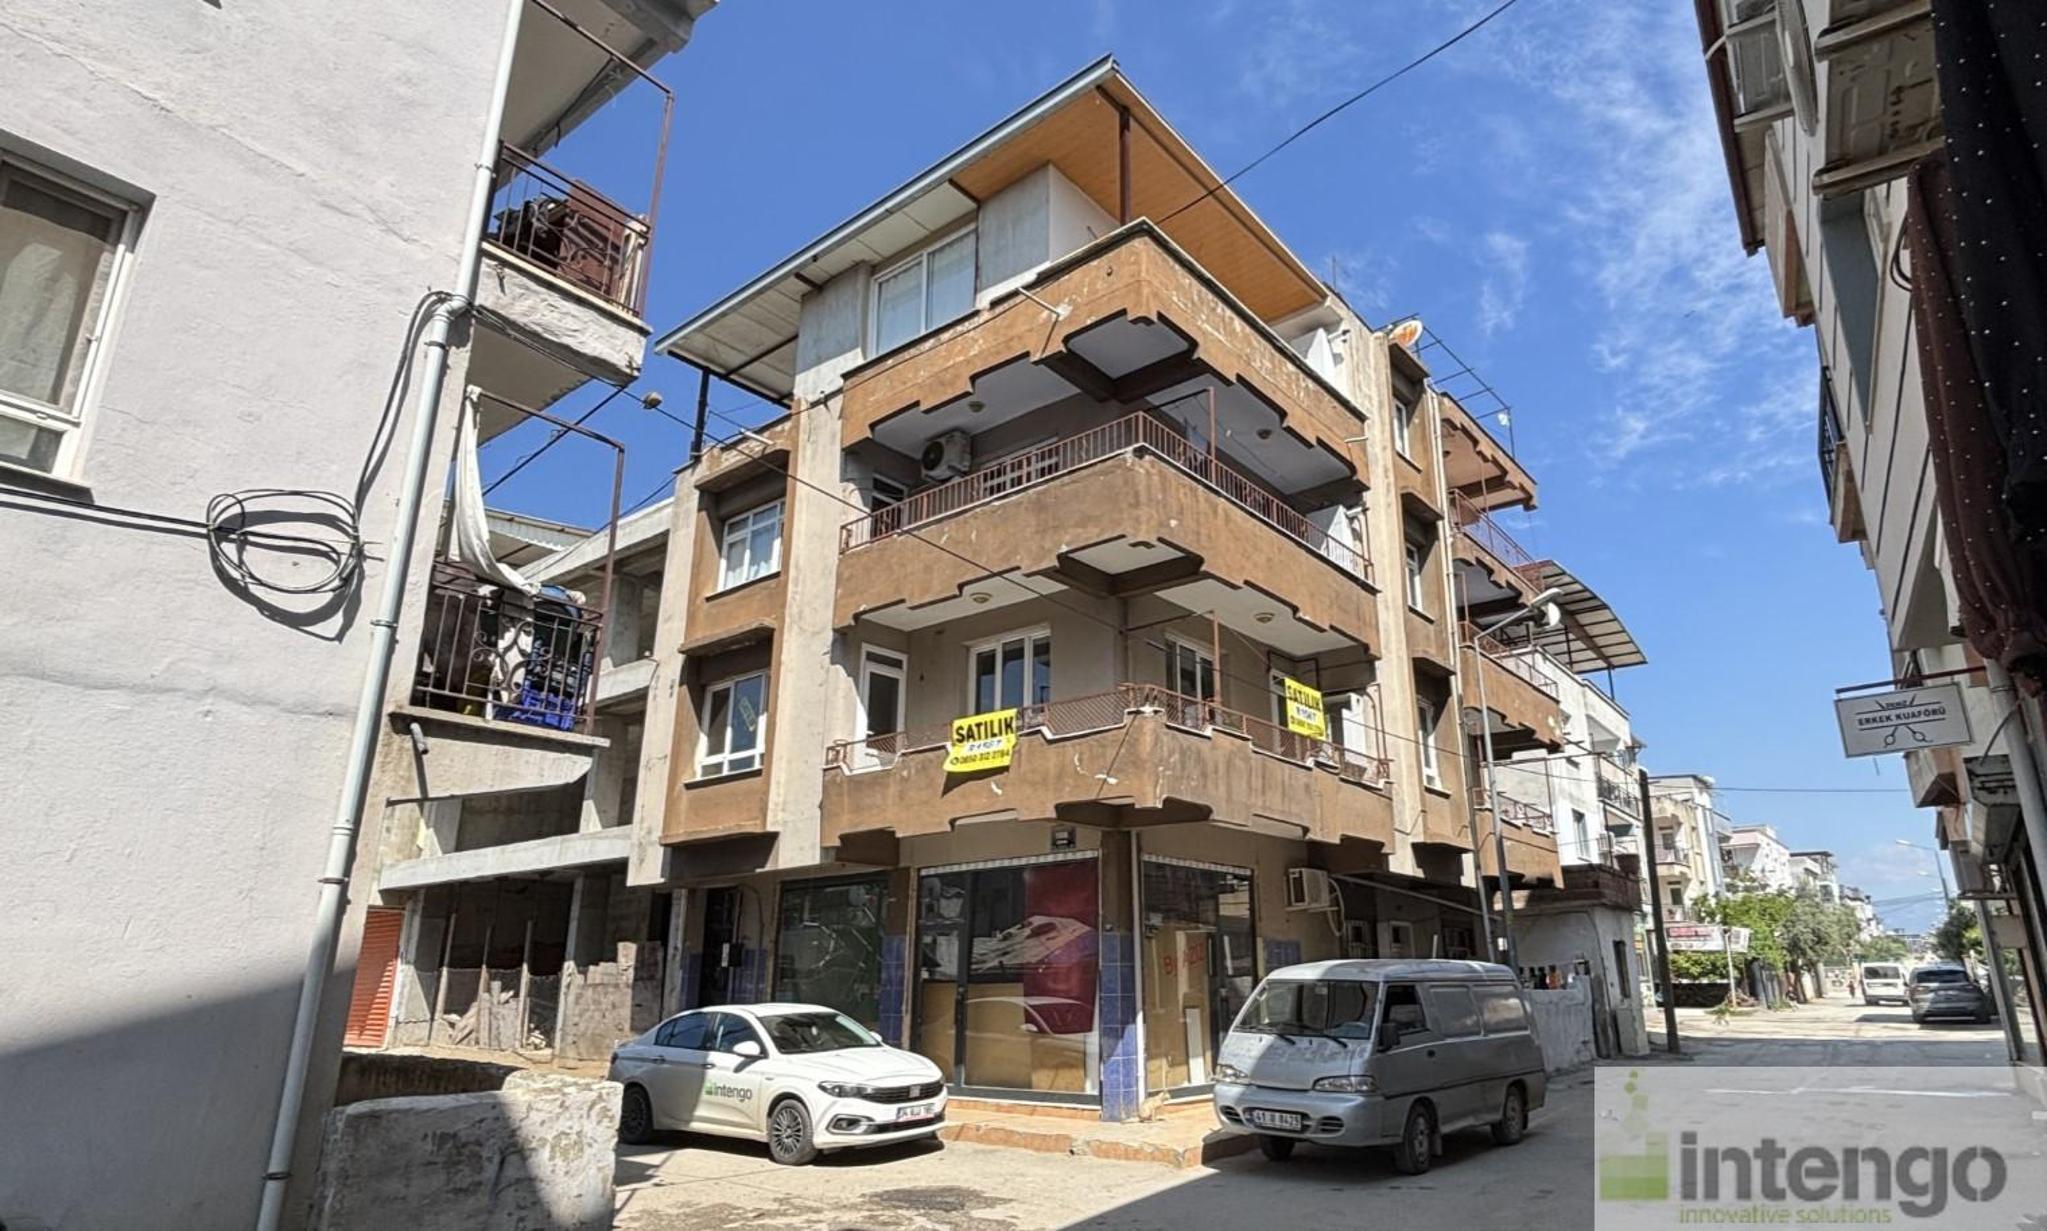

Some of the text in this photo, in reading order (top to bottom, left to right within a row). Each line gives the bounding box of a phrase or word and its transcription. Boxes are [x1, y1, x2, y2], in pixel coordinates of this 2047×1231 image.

[955, 716, 1014, 744] SATILIK
[1858, 714, 1894, 727] ERKEK
[713, 1082, 753, 1103] intengo
